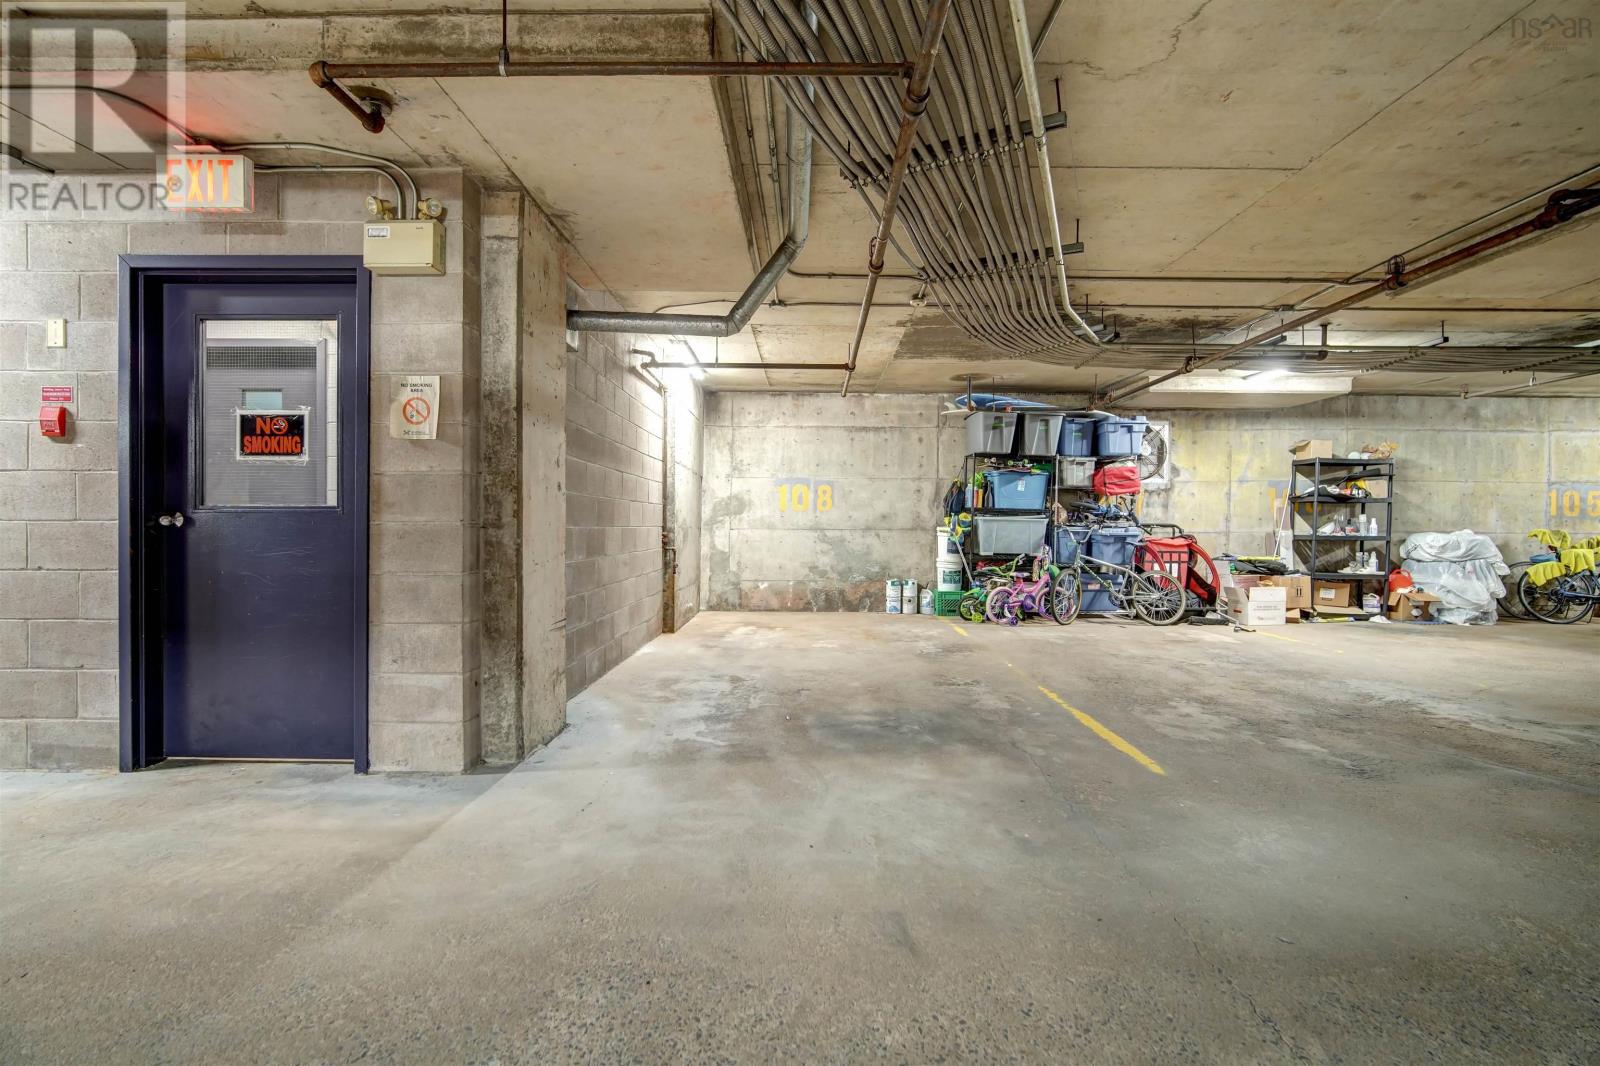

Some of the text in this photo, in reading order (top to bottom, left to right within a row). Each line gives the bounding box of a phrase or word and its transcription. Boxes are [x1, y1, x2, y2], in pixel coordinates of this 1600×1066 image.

[166, 159, 234, 202] EXIT
[255, 416, 289, 435] NO
[243, 435, 302, 454] SMOKING
[777, 483, 833, 513] 108
